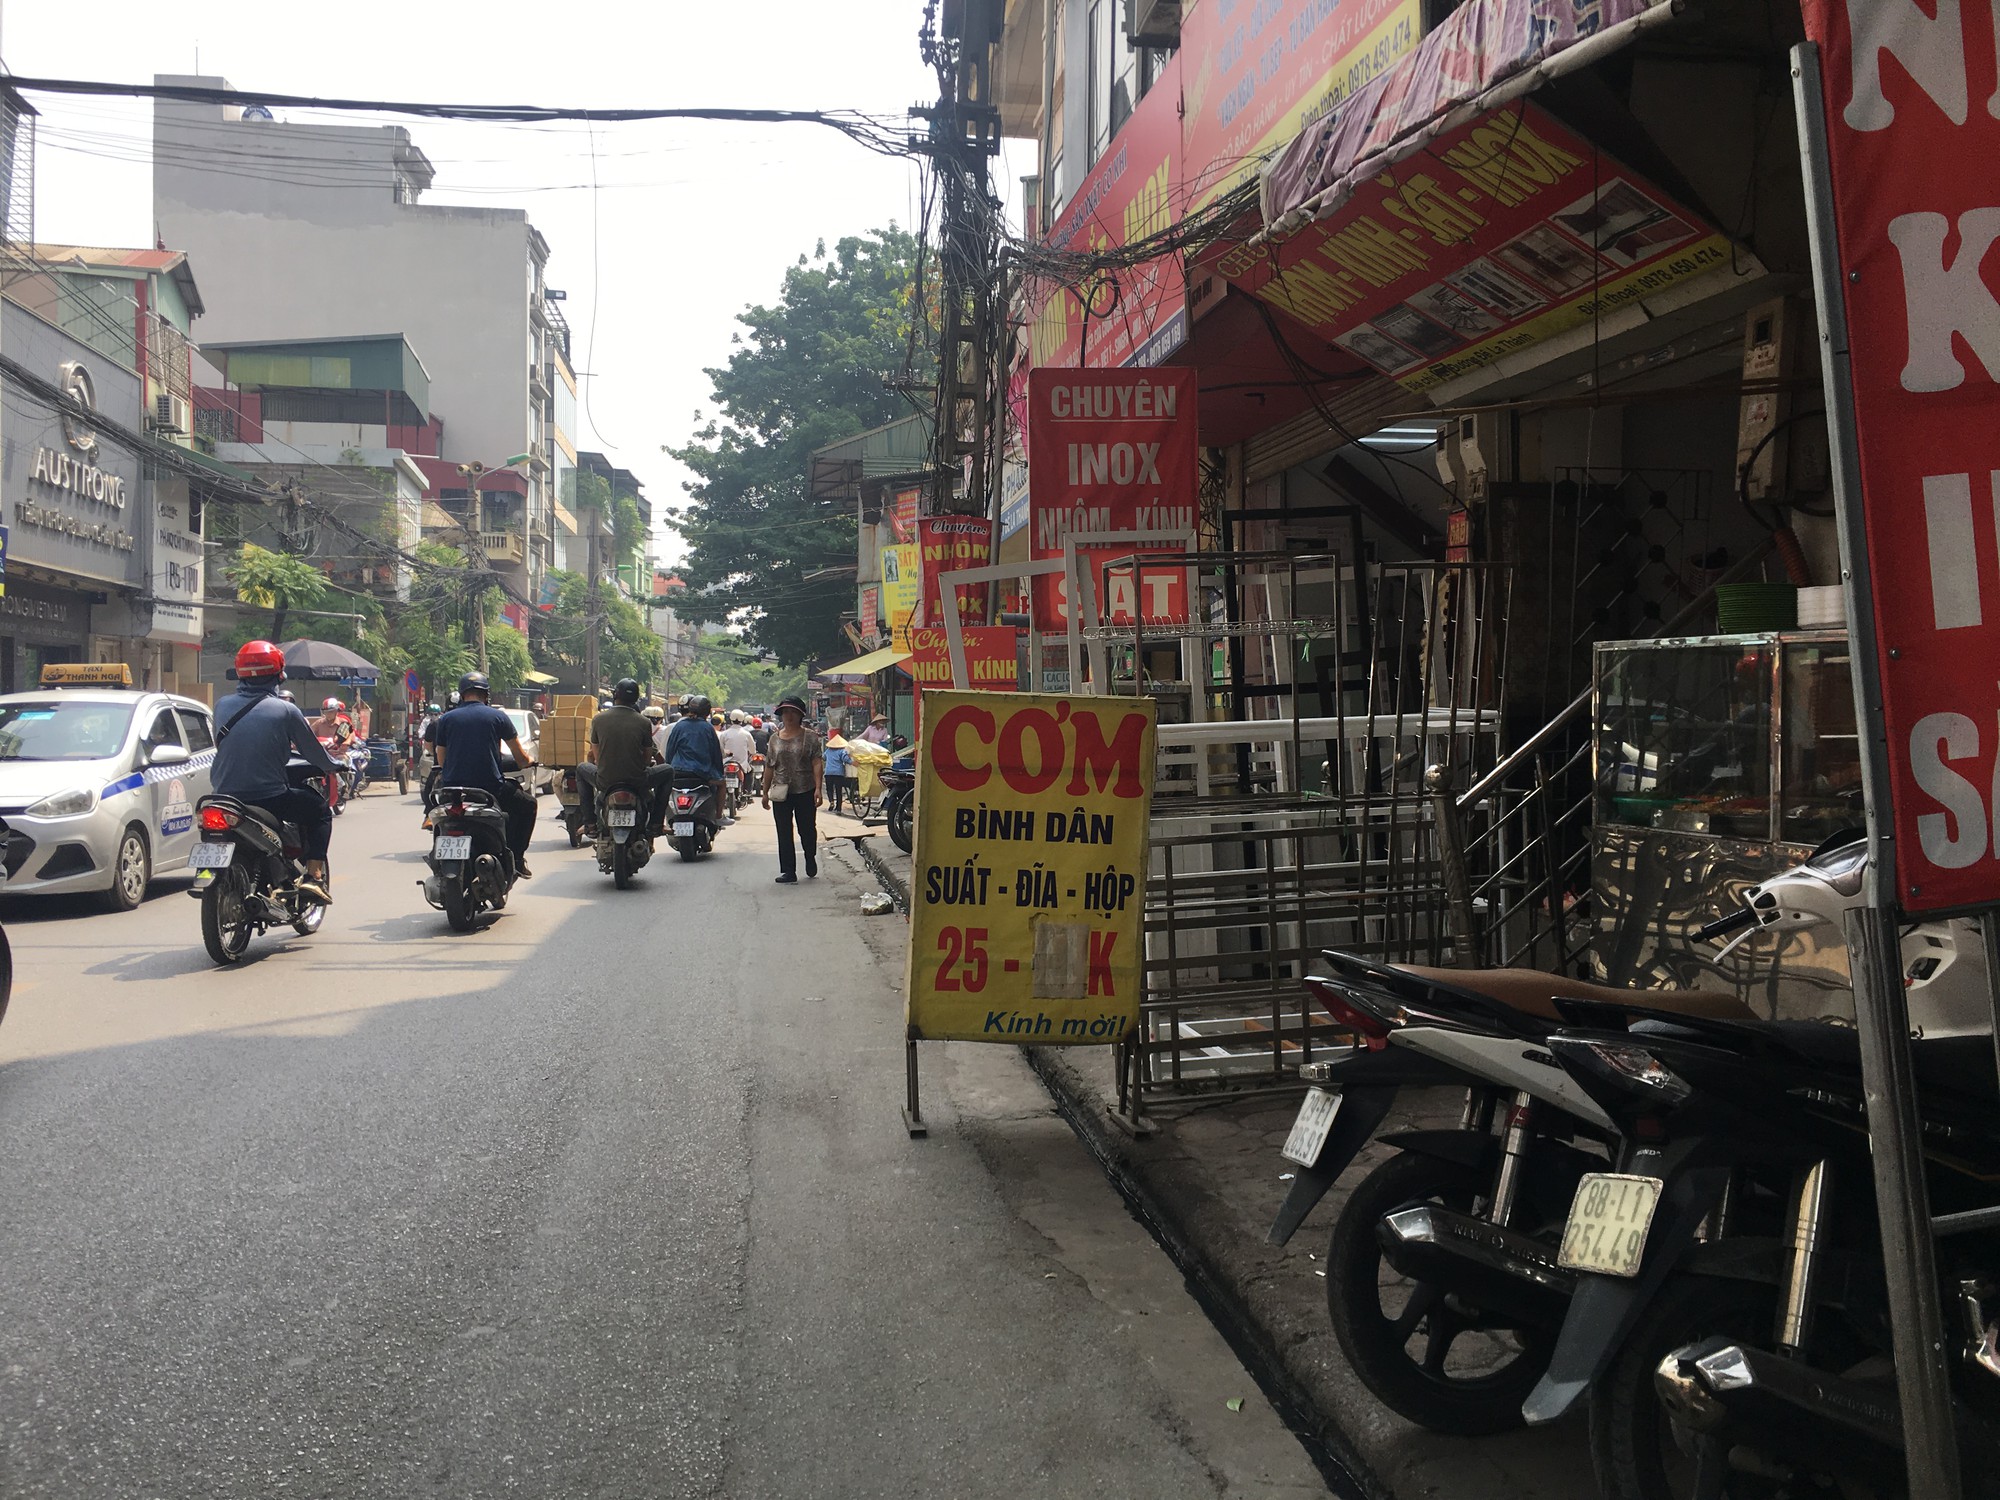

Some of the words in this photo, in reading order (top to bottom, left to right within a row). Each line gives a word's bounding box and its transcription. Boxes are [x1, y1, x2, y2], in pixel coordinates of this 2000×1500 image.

[1348, 52, 1372, 94] 0978
[1373, 34, 1390, 72] 450
[1393, 14, 1412, 55] 474
[1123, 152, 1173, 248] INOX
[1314, 214, 1433, 289] KÍNH
[1374, 171, 1491, 247] SẮT
[1440, 108, 1586, 209] INOX
[1639, 267, 1671, 290] 0978
[1671, 256, 1698, 279] 450
[1697, 246, 1725, 268] 474
[1050, 379, 1177, 418] CHUYÊN
[34, 446, 126, 509] AUSTRONG
[1068, 442, 1162, 486] INOX
[930, 519, 991, 536] Chuyên:
[1038, 498, 1112, 549] NHÔM
[1135, 498, 1194, 549] KÍNH
[924, 540, 991, 562] NHÔM
[933, 596, 984, 615] IOX
[66, 673, 98, 682] THANH
[101, 673, 121, 682] NGA
[82, 665, 104, 673] TAXI
[912, 657, 952, 681] NHÔ
[973, 655, 1018, 680] KÍNH
[931, 700, 1148, 798] CƠM
[440, 838, 467, 849] 29-X7
[955, 803, 1035, 841] BÌNH
[1045, 807, 1114, 845] DÂN
[190, 855, 229, 868] 366.87
[436, 848, 470, 860] 371.91
[925, 854, 991, 906] SUẤT
[1015, 862, 1058, 908] ĐĨA
[1084, 865, 1135, 919] HỘP
[934, 926, 989, 993] 25
[984, 1011, 1053, 1036] Kính
[1061, 1013, 1126, 1038] mời!
[1583, 1180, 1645, 1223] 88-L1
[1567, 1222, 1641, 1266] 254.49
